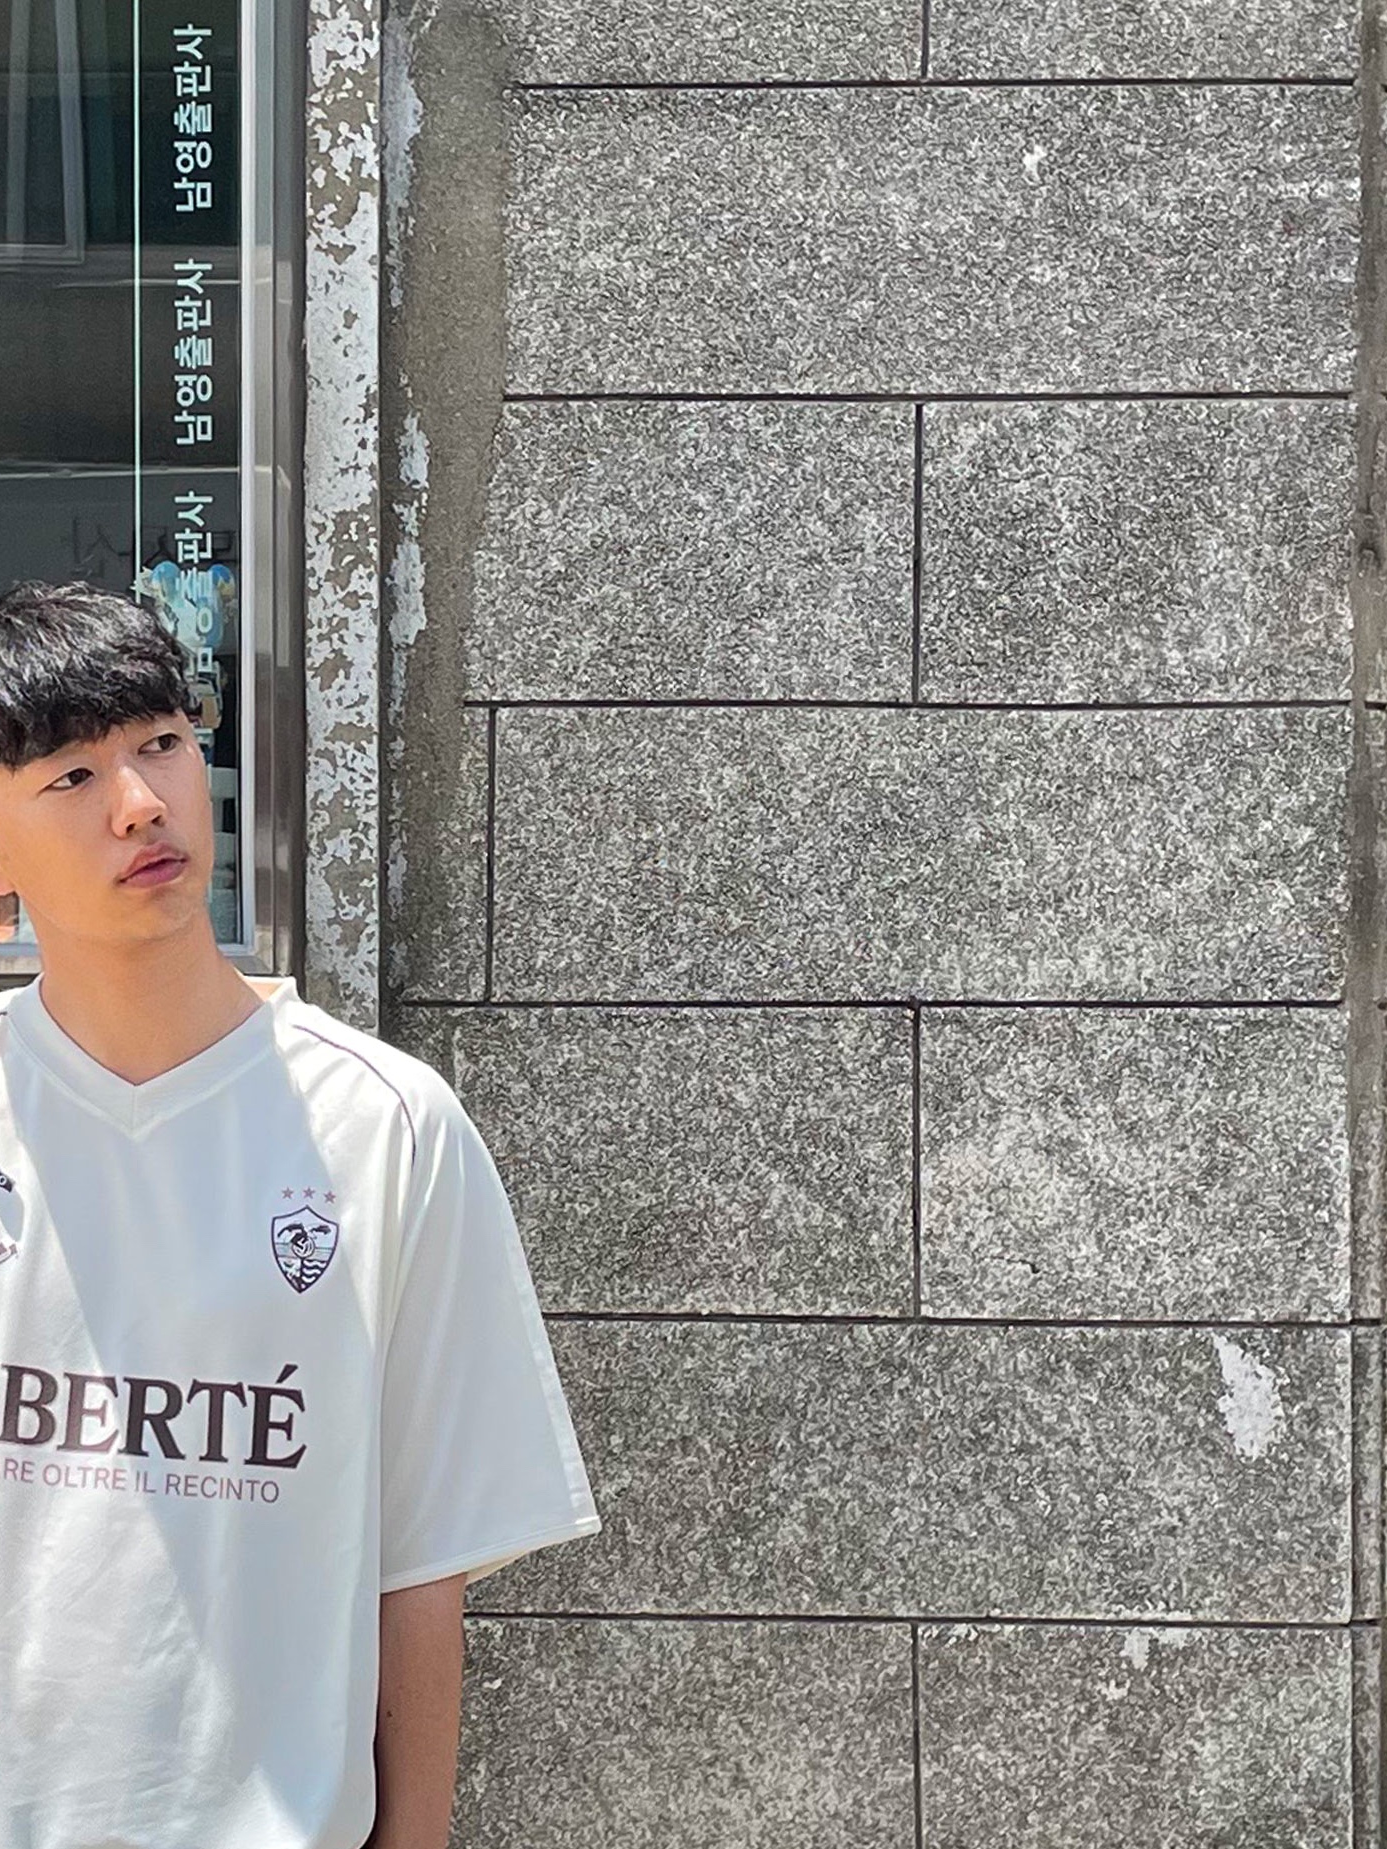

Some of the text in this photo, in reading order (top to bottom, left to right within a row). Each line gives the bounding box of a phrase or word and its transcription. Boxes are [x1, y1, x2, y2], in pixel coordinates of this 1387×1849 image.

[173, 23, 213, 212] 남영출판사
[173, 258, 213, 445] 남영출판사
[41, 1462, 128, 1492] OLTRE
[134, 1470, 157, 1495] IL
[164, 1473, 281, 1504] RECINTO
